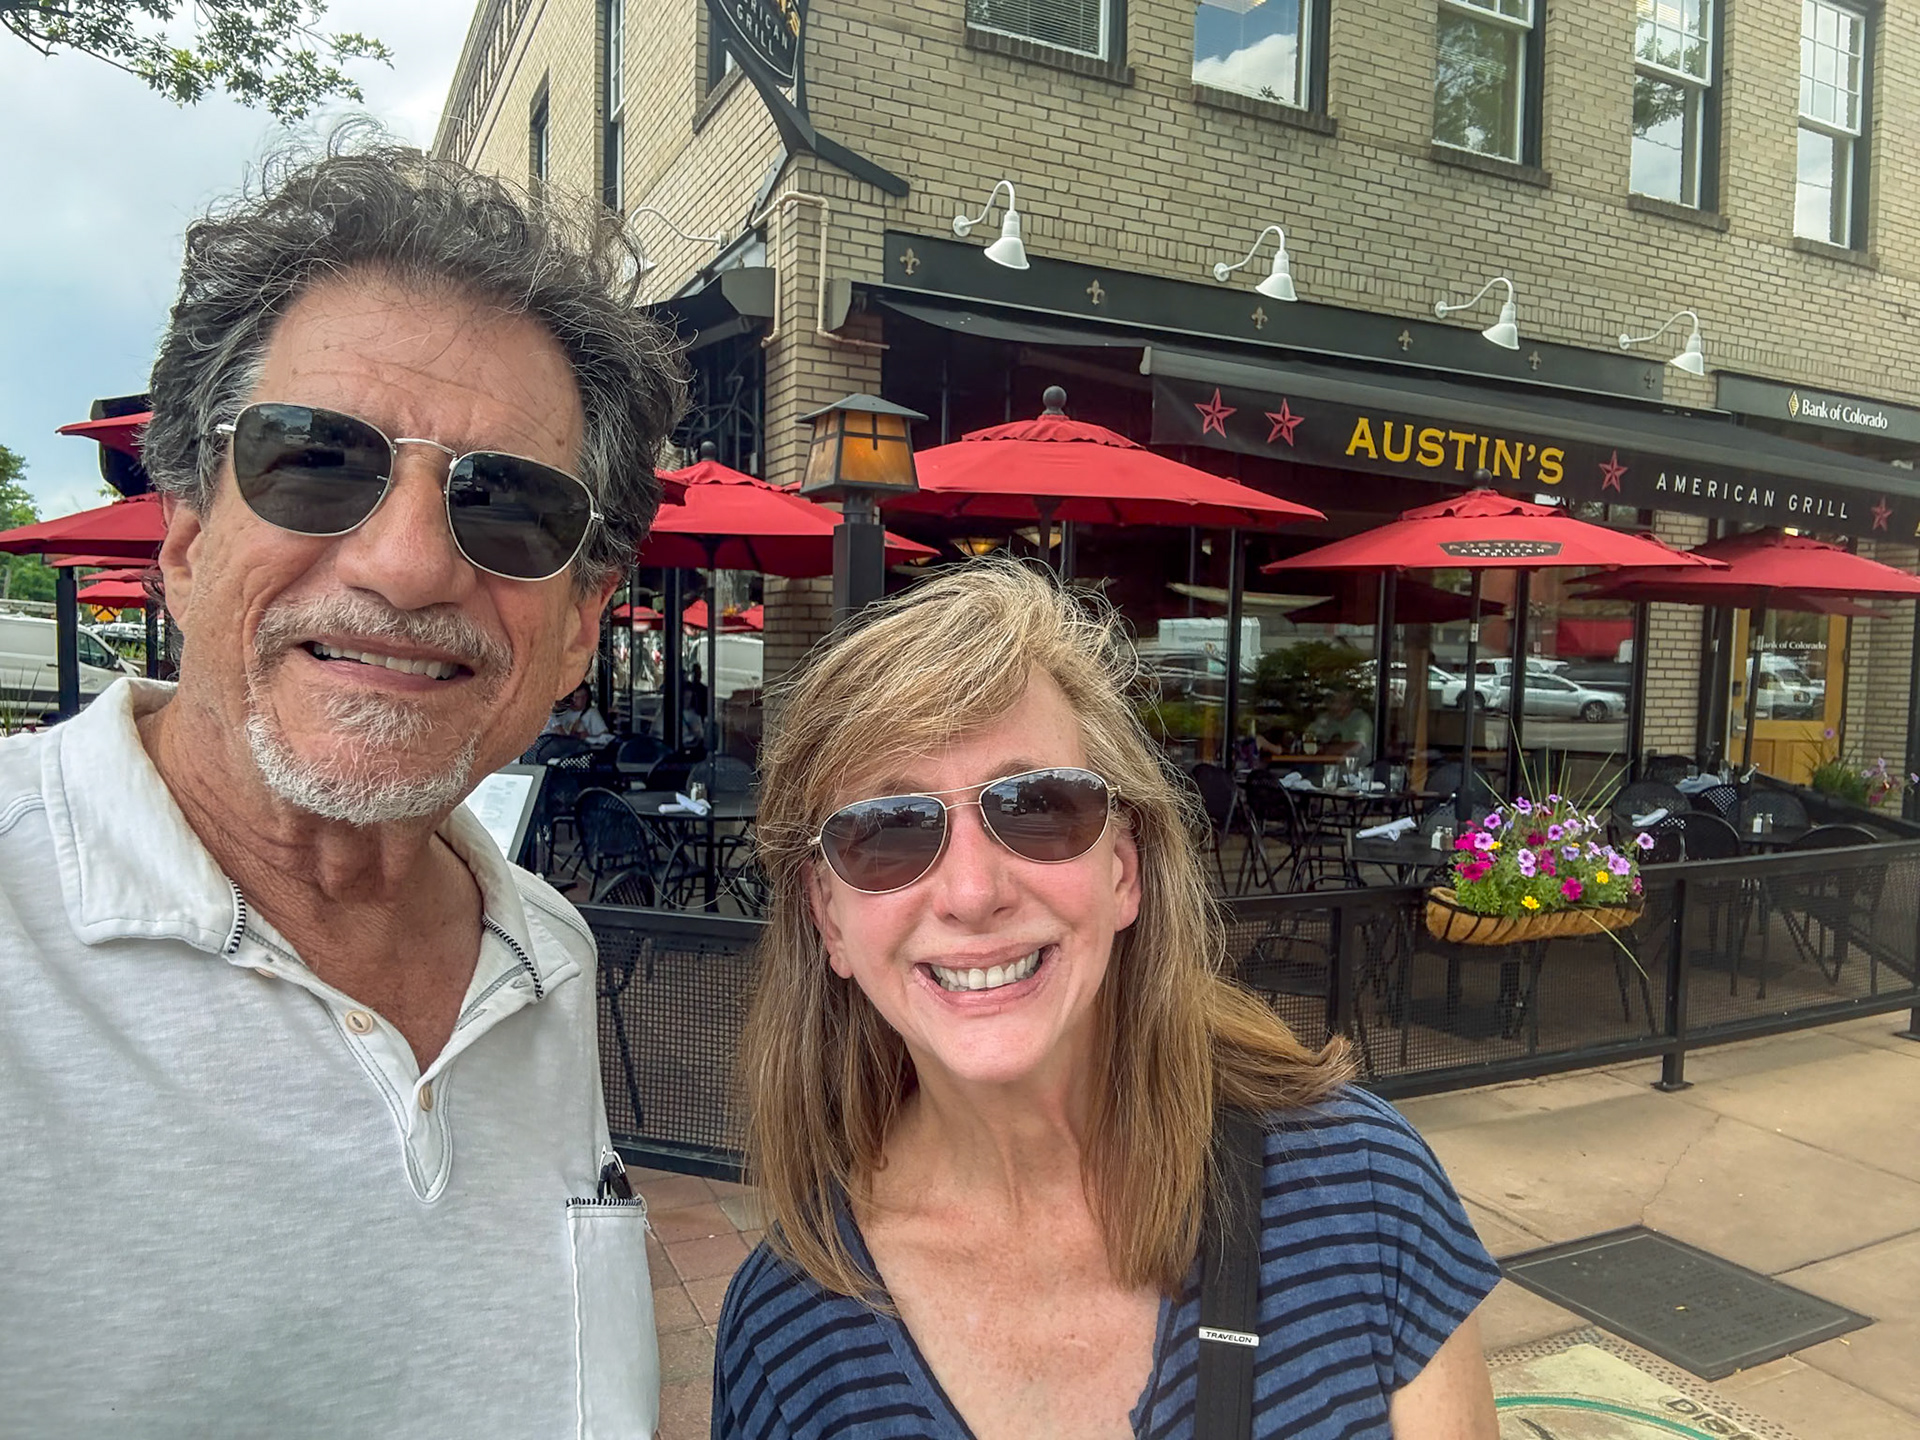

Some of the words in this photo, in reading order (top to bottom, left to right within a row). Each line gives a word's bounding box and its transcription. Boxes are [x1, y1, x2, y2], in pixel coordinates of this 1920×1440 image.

[736, 4, 774, 56] GRILL
[1802, 399, 1828, 419] Bank
[1829, 405, 1841, 421] of
[1842, 406, 1888, 429] Colorado
[1345, 417, 1565, 484] AUSTIN'S
[1656, 472, 1775, 507] AMERICAN
[1788, 494, 1848, 519] GRILL
[1779, 641, 1788, 650] of
[1789, 641, 1827, 650] Colorado
[1206, 1331, 1253, 1344] TRAVELON
